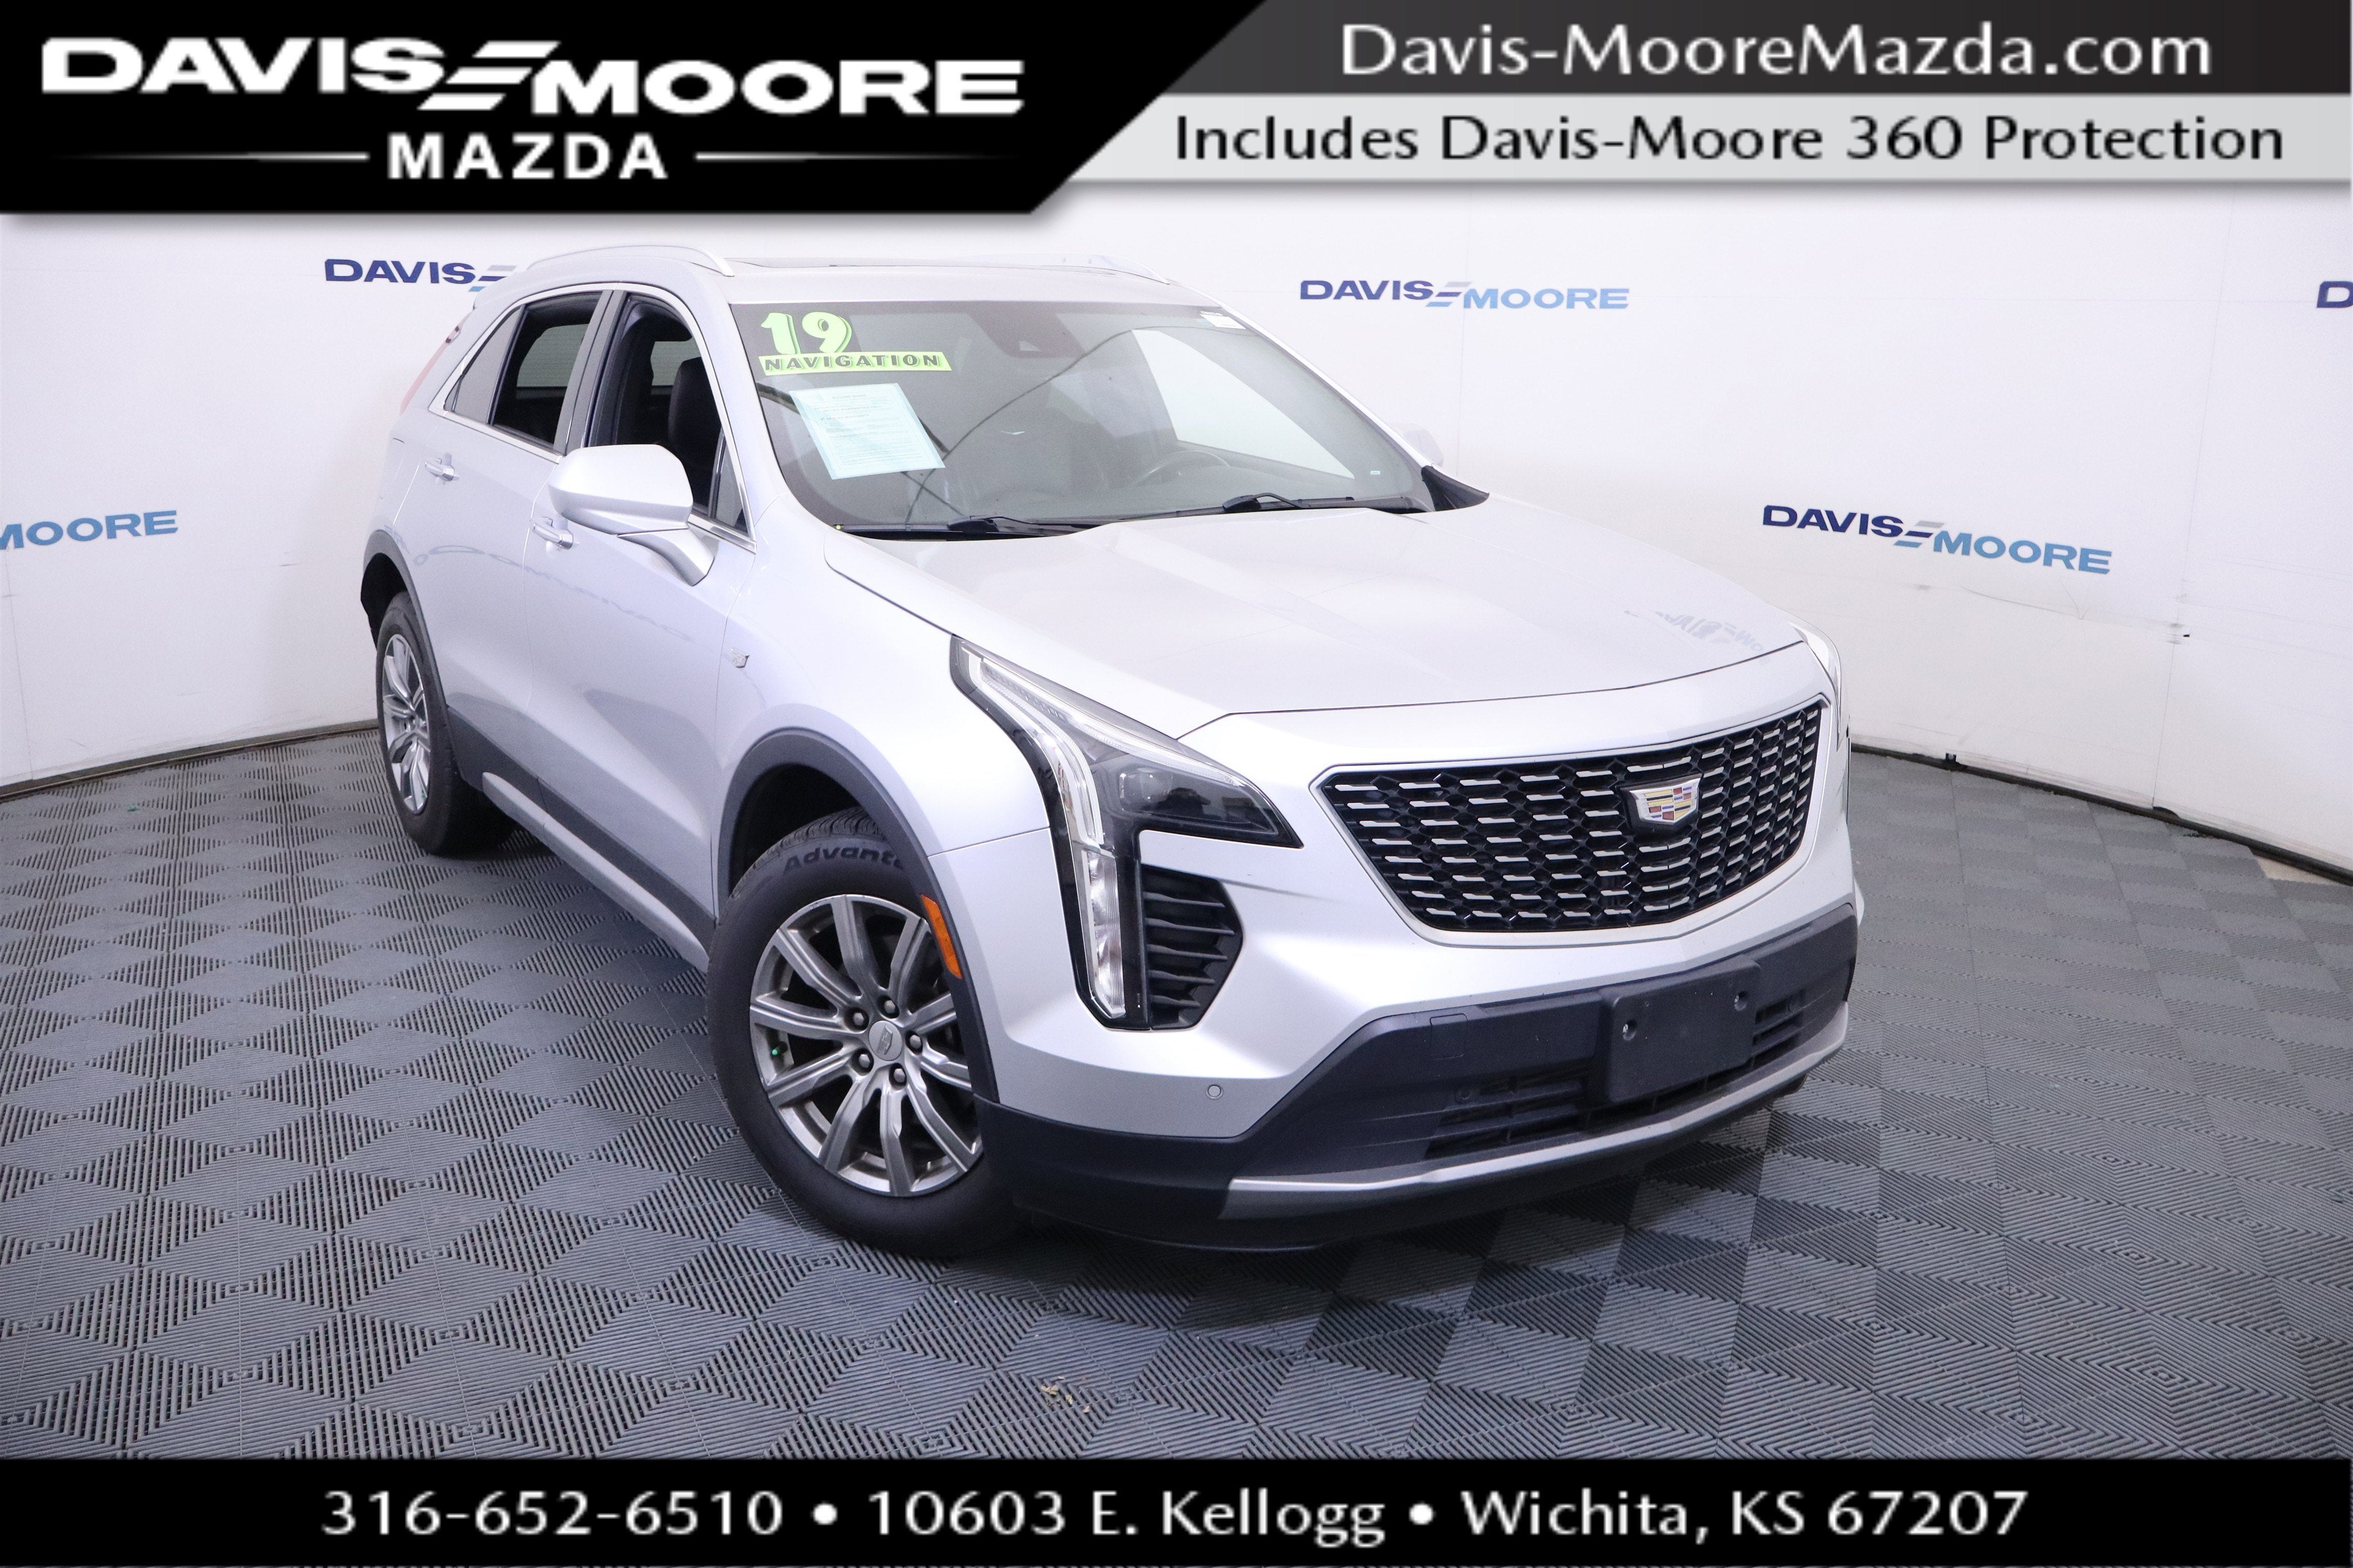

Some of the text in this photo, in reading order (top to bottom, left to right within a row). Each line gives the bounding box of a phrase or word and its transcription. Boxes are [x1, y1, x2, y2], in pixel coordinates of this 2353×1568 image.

[325, 258, 476, 284] DAVIS
[1300, 280, 1630, 309] DAVIS MOORE
[761, 311, 852, 354] 19
[765, 354, 940, 370] NAVIGATION
[0, 510, 178, 550] MOORE
[1762, 505, 2112, 574] DAVIS MOORE
